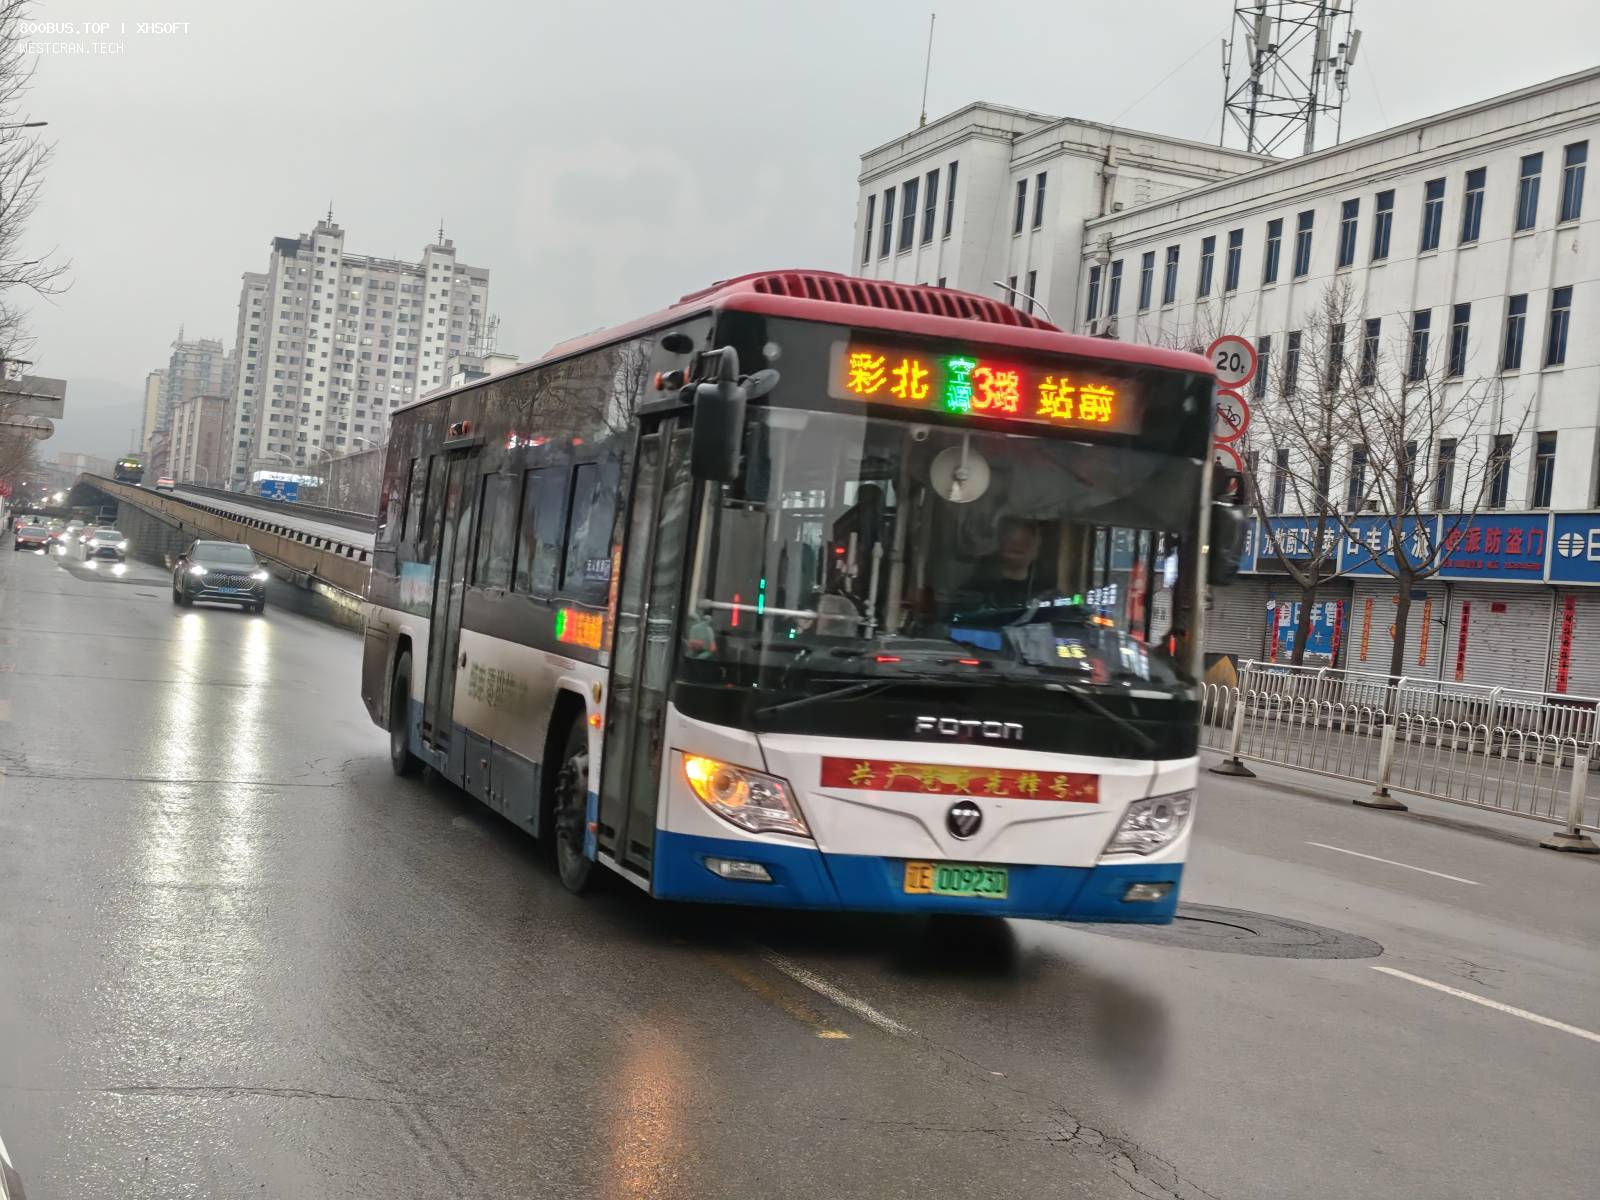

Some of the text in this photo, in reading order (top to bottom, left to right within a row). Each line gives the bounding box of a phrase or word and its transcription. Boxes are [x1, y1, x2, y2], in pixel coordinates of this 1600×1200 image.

[846, 353, 930, 400] 彩北
[1035, 376, 1115, 422] 站前
[915, 716, 1024, 741] FOTON
